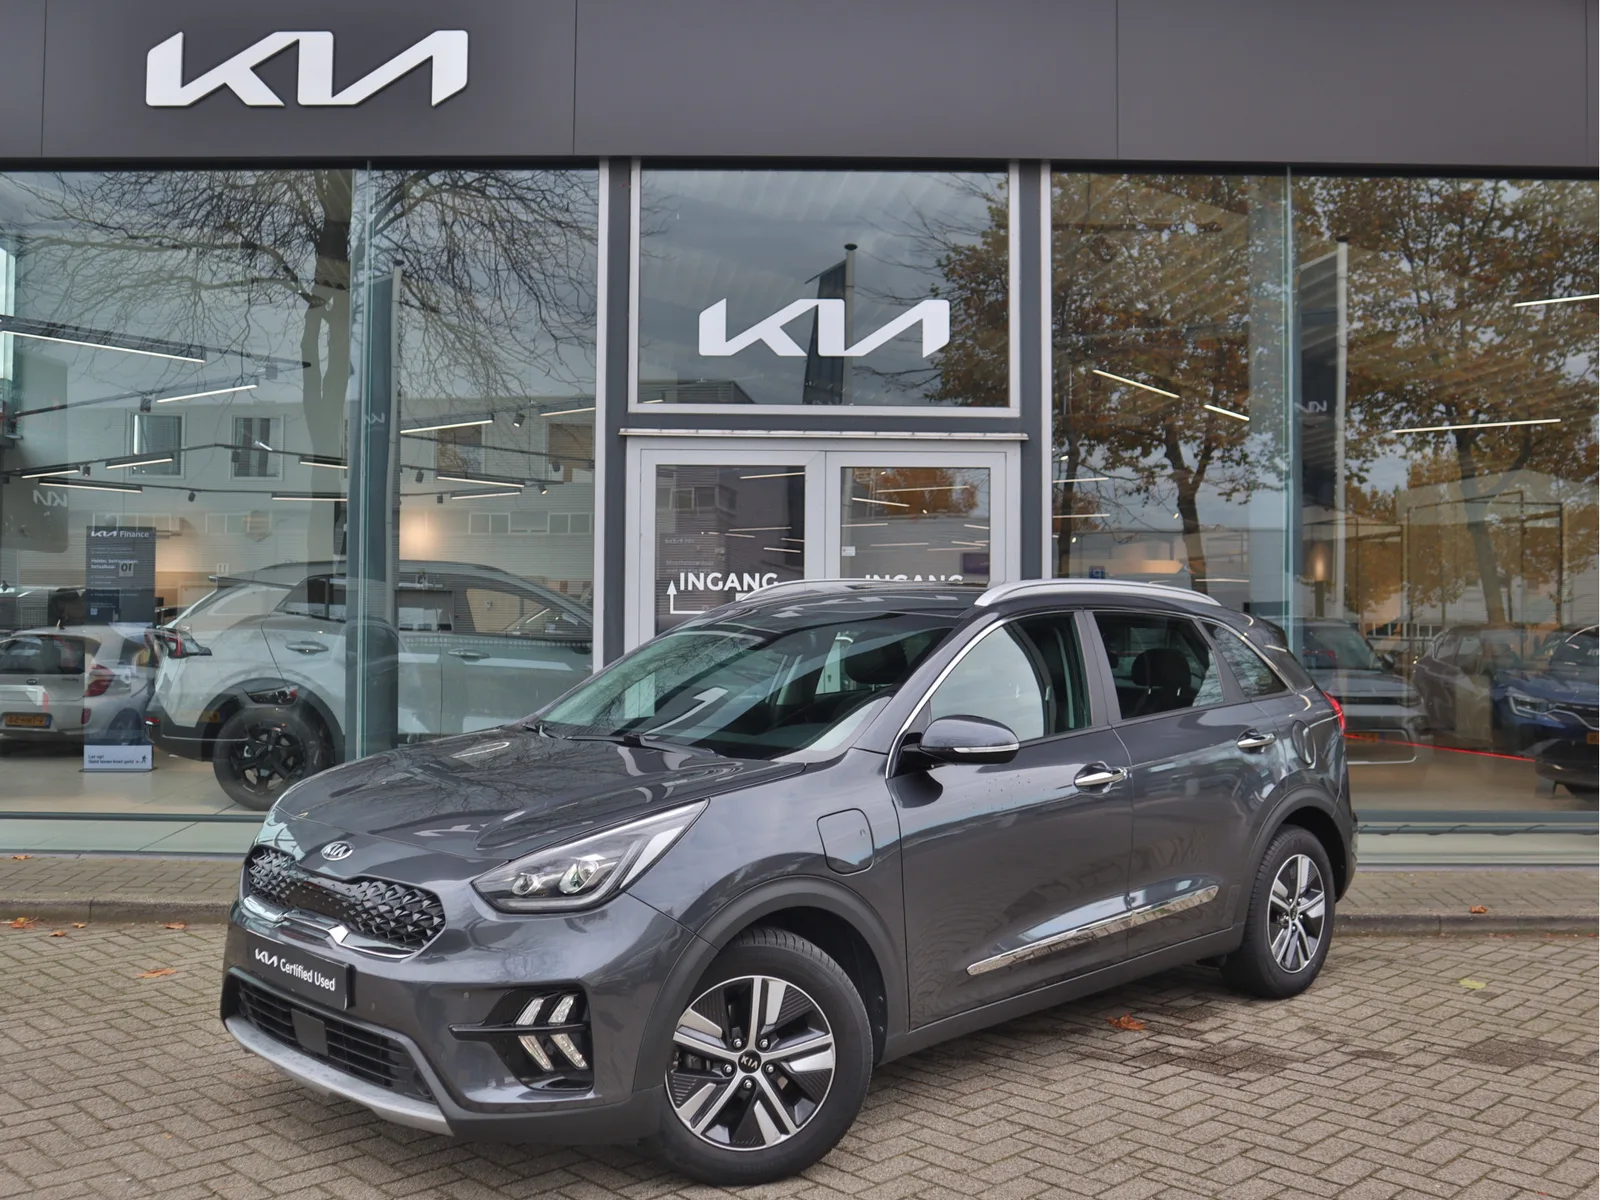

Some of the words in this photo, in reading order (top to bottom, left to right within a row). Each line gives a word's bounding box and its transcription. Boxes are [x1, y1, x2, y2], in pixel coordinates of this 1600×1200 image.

[145, 30, 469, 107] KIA
[698, 298, 951, 358] KIA
[119, 530, 150, 538] Finance
[680, 572, 778, 591] INGANG
[255, 948, 278, 968] KIA
[280, 958, 313, 983] Certified
[314, 971, 336, 992] Used
[740, 1055, 759, 1070] KIA
